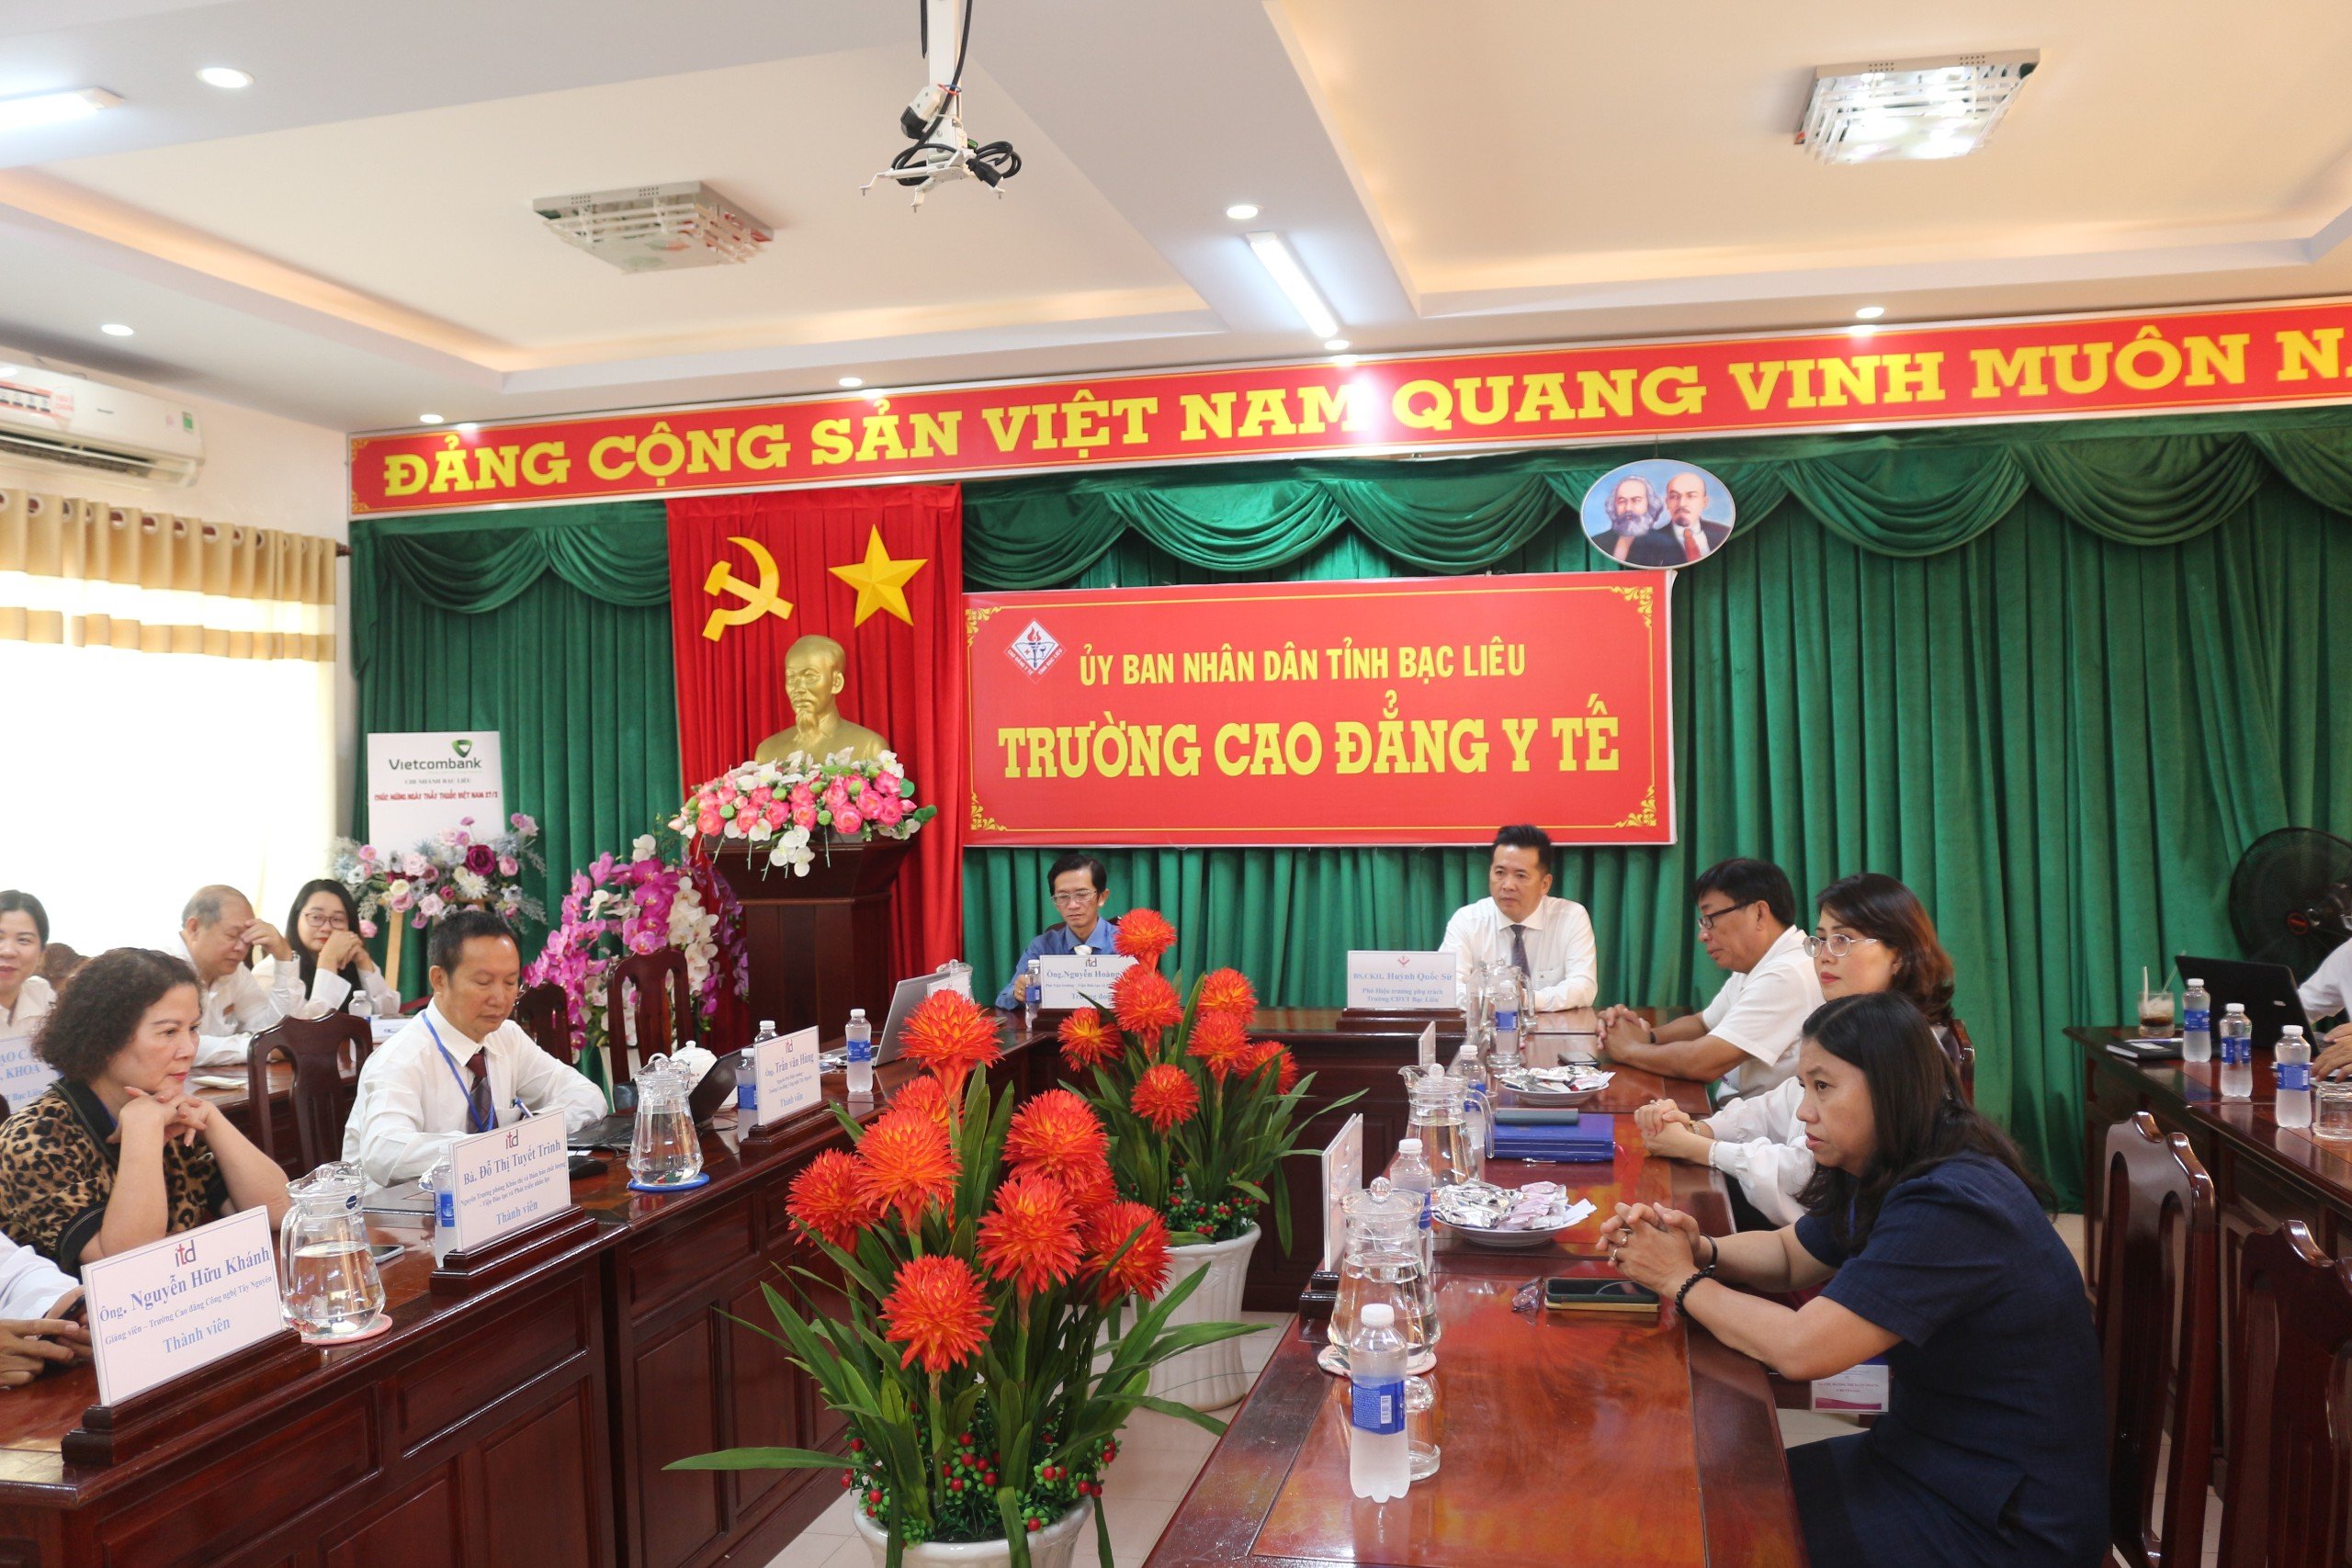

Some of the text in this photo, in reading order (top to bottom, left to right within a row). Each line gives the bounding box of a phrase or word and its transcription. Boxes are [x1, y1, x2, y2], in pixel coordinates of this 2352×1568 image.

[384, 325, 2352, 496] ĐẢNG CỘNG SẢN VIỆT NAM QUANG VINH MUÔN N
[1080, 636, 1526, 686] ỦY BAN NHÂN DÂN TỈNH BẠC LIÊU
[998, 688, 1620, 778] TRƯỜNG CAO ĐẲNG Y TẾ
[389, 758, 482, 770] Vietcombank
[505, 1129, 519, 1149] itd
[480, 1160, 492, 1179] Đỗ
[493, 1157, 510, 1173] Thị
[512, 1145, 536, 1167] Tuyết
[496, 1200, 537, 1224] Thành viên
[175, 1239, 197, 1267] itd
[99, 1247, 270, 1323] Ông. Nguyễn Hữu Khánh
[163, 1317, 231, 1354] Thành viên
